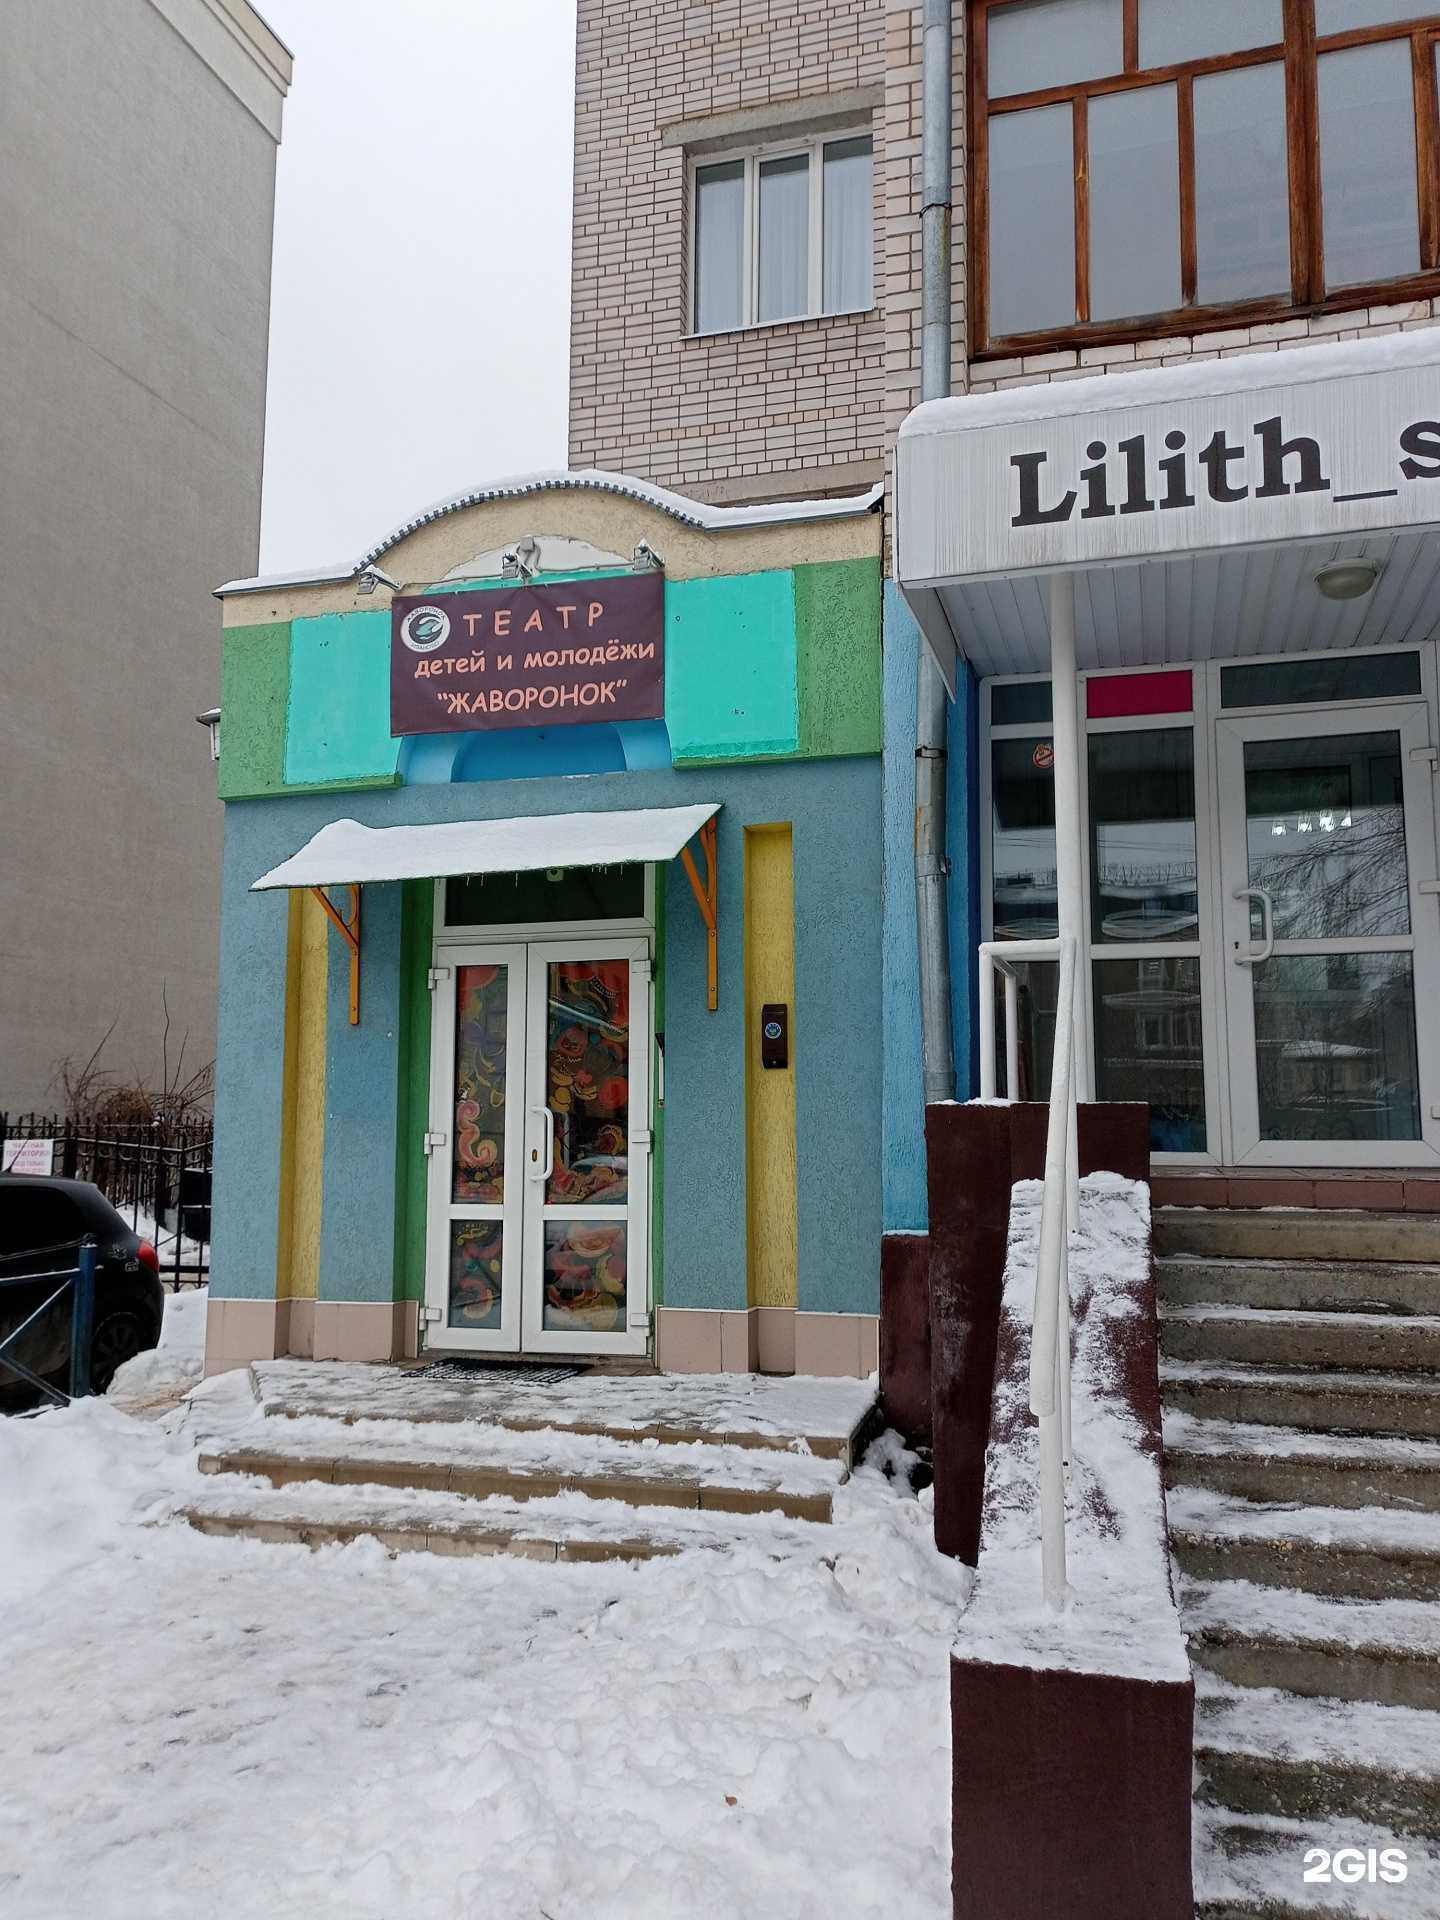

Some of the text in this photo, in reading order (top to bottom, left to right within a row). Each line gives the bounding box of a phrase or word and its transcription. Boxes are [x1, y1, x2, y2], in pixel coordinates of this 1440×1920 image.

[463, 602, 604, 637] ТЕАТР
[414, 639, 655, 679] детей и молодёжи
[437, 679, 628, 714] "ЖАВОРОНОК"
